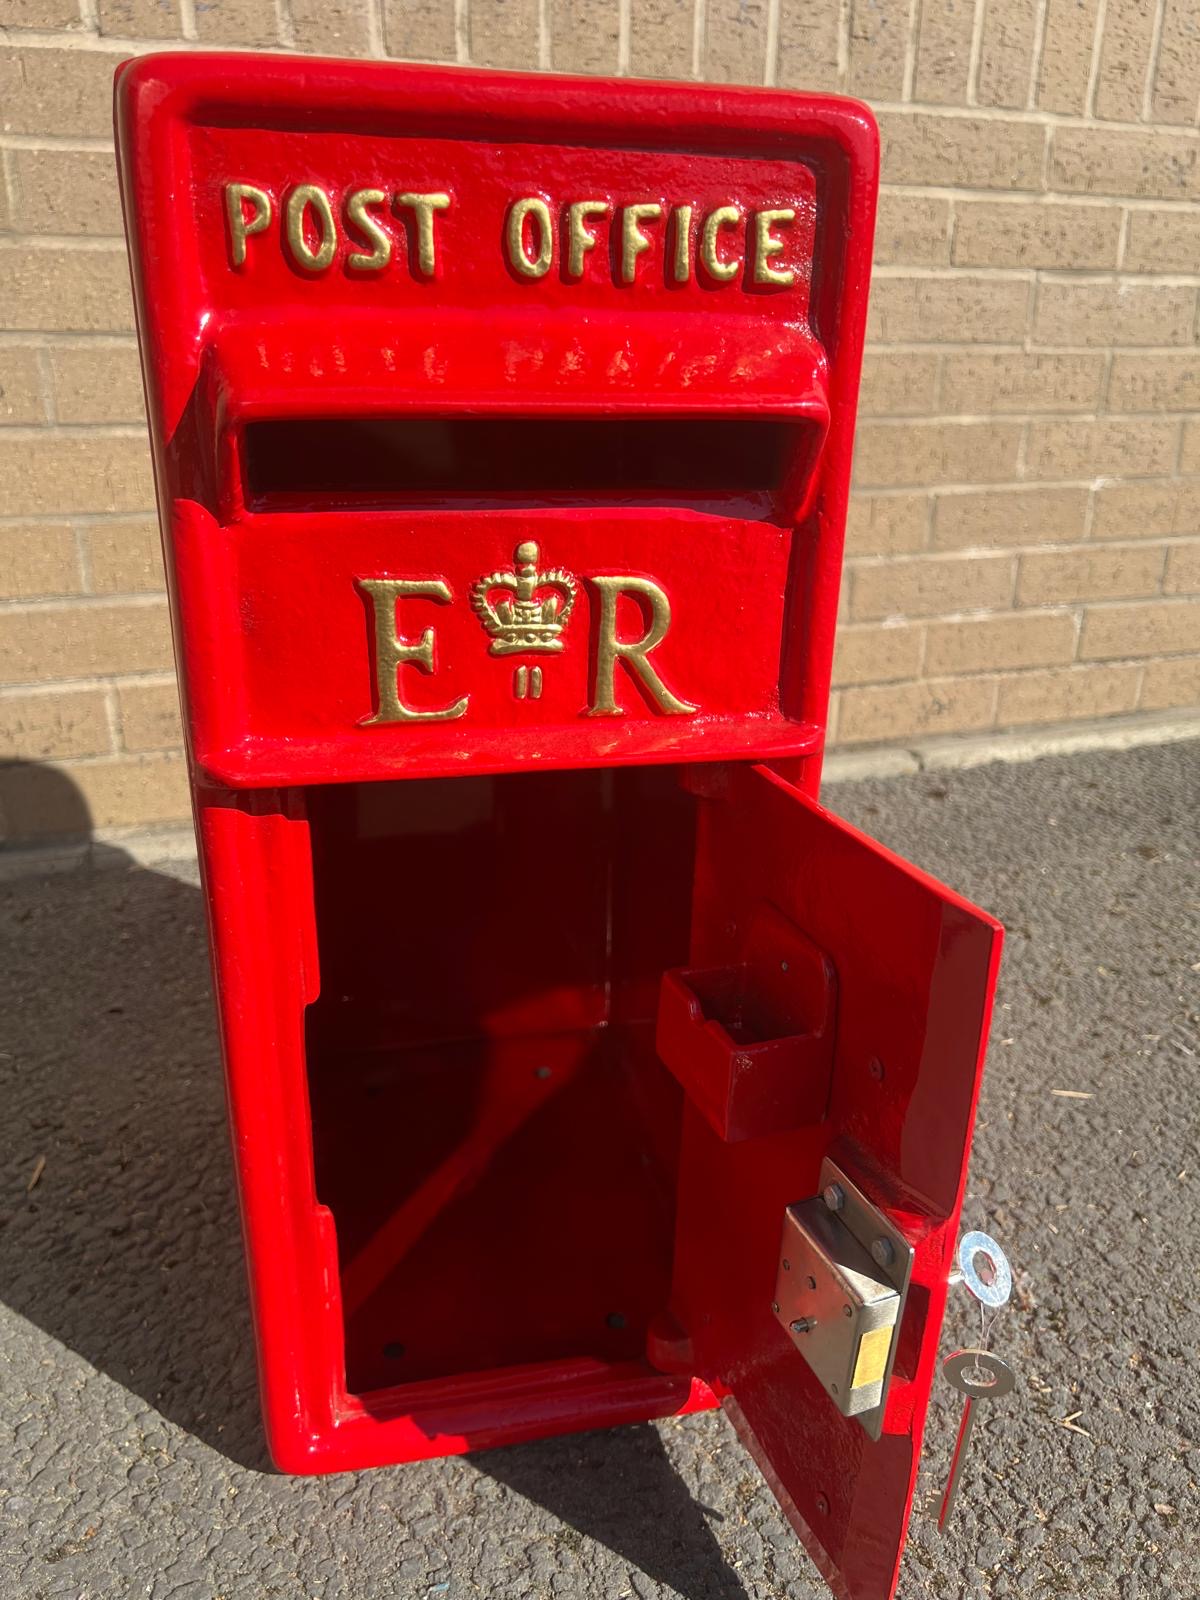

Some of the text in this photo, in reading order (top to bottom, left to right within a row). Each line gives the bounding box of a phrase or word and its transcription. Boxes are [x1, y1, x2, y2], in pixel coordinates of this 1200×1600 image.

[224, 181, 797, 286] POST OFFICE
[356, 575, 698, 727] E R
